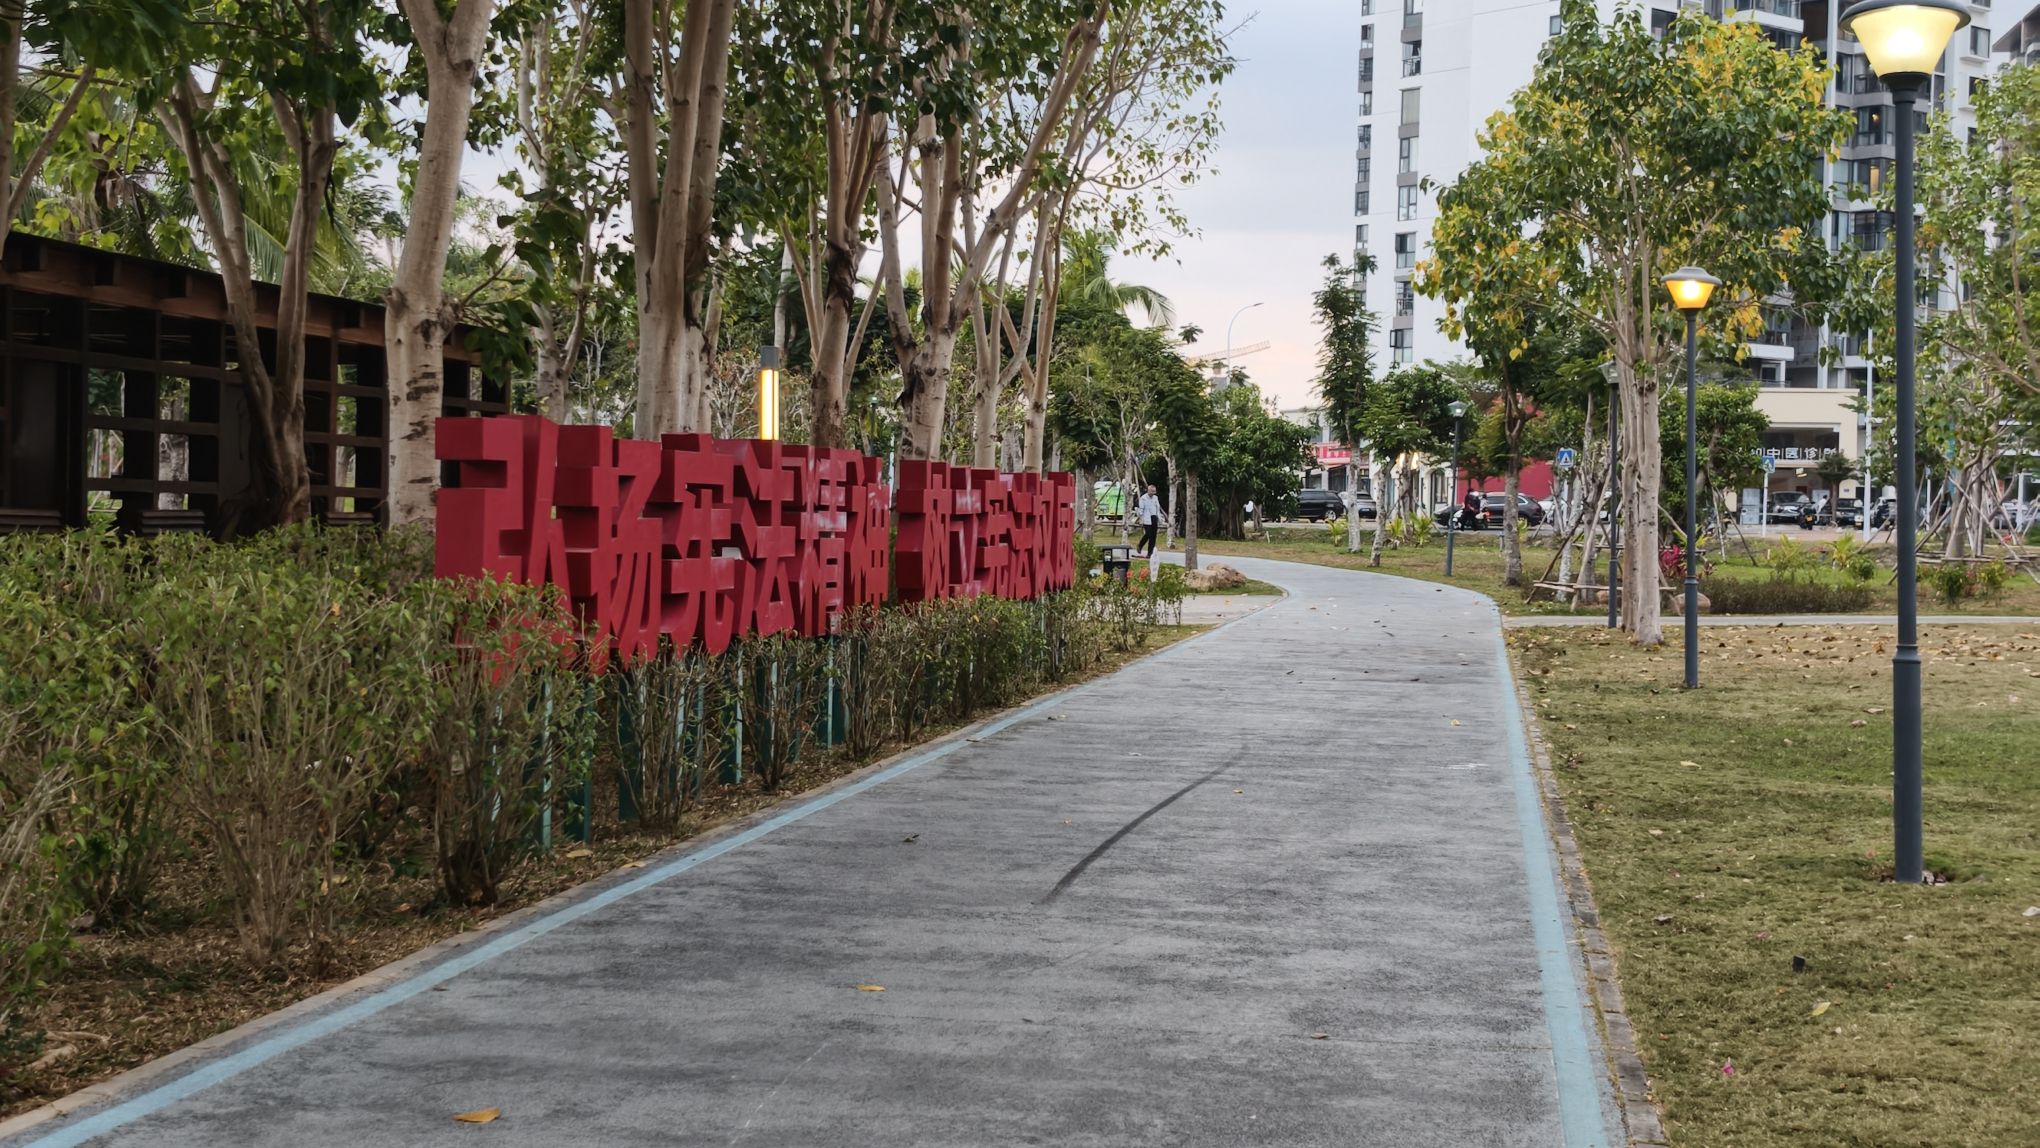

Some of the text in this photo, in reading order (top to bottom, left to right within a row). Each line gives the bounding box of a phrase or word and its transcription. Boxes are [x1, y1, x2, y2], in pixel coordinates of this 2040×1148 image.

[897, 460, 1076, 602] 树立宪法权威
